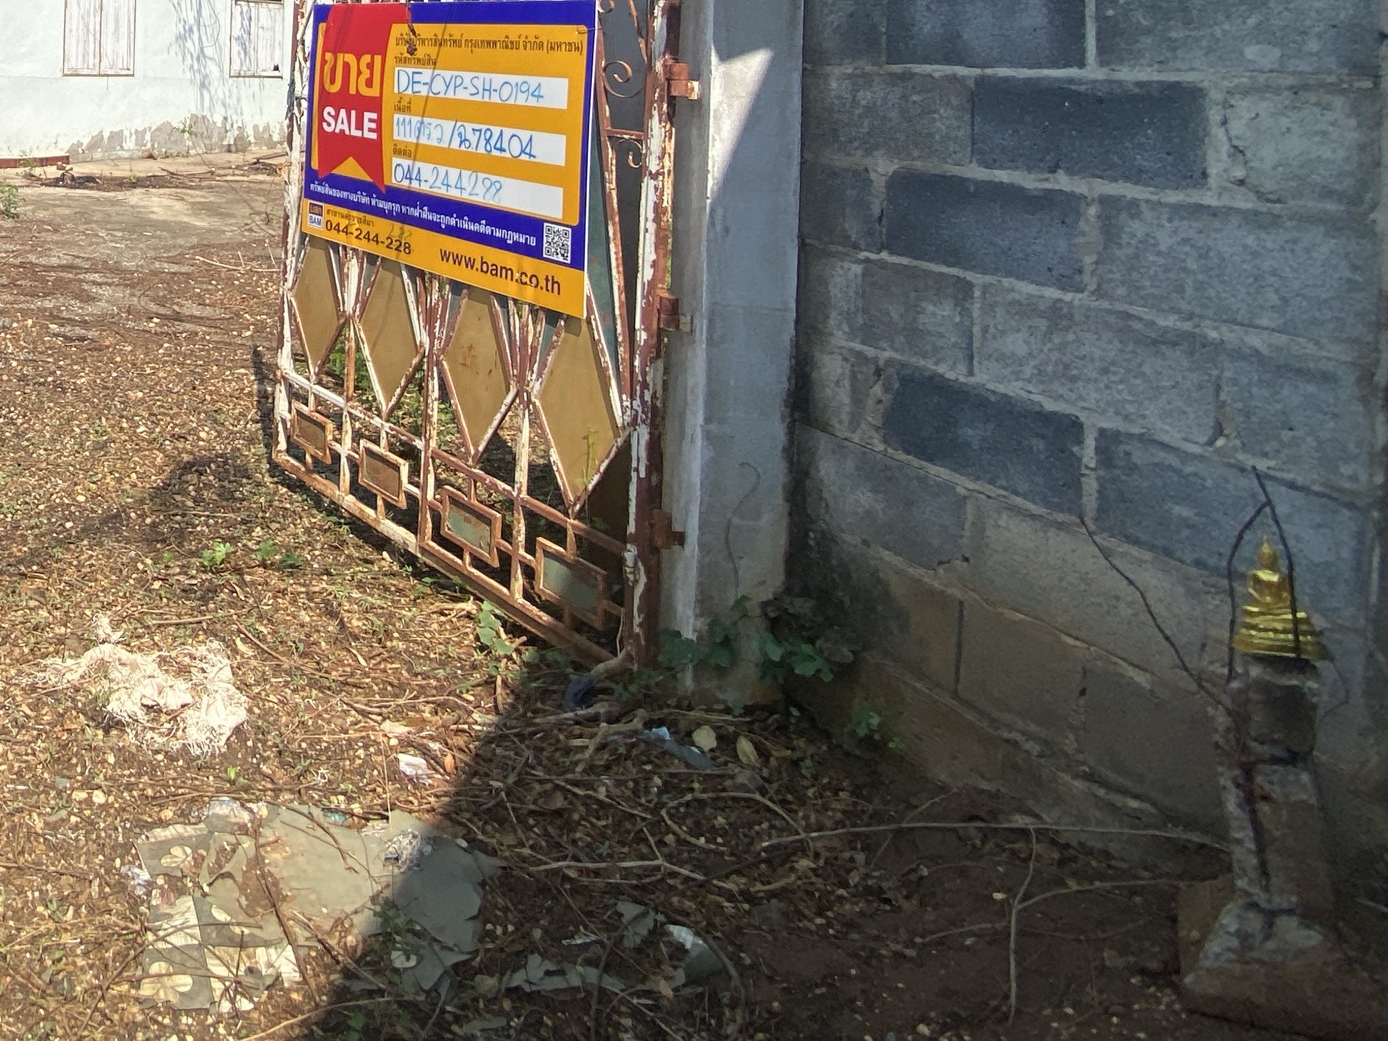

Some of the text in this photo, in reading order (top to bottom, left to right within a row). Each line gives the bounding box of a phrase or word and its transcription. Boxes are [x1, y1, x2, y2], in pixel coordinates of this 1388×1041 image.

[522, 35, 544, 52] จำกัด
[546, 39, 584, 55] (มหาชน)
[323, 52, 382, 97] ขาย
[322, 106, 378, 139] SALE
[393, 143, 412, 158] ติดต่อ
[309, 215, 322, 226] BAM
[325, 219, 412, 255] 044-244-228
[439, 248, 561, 295] www.bam.co.th
